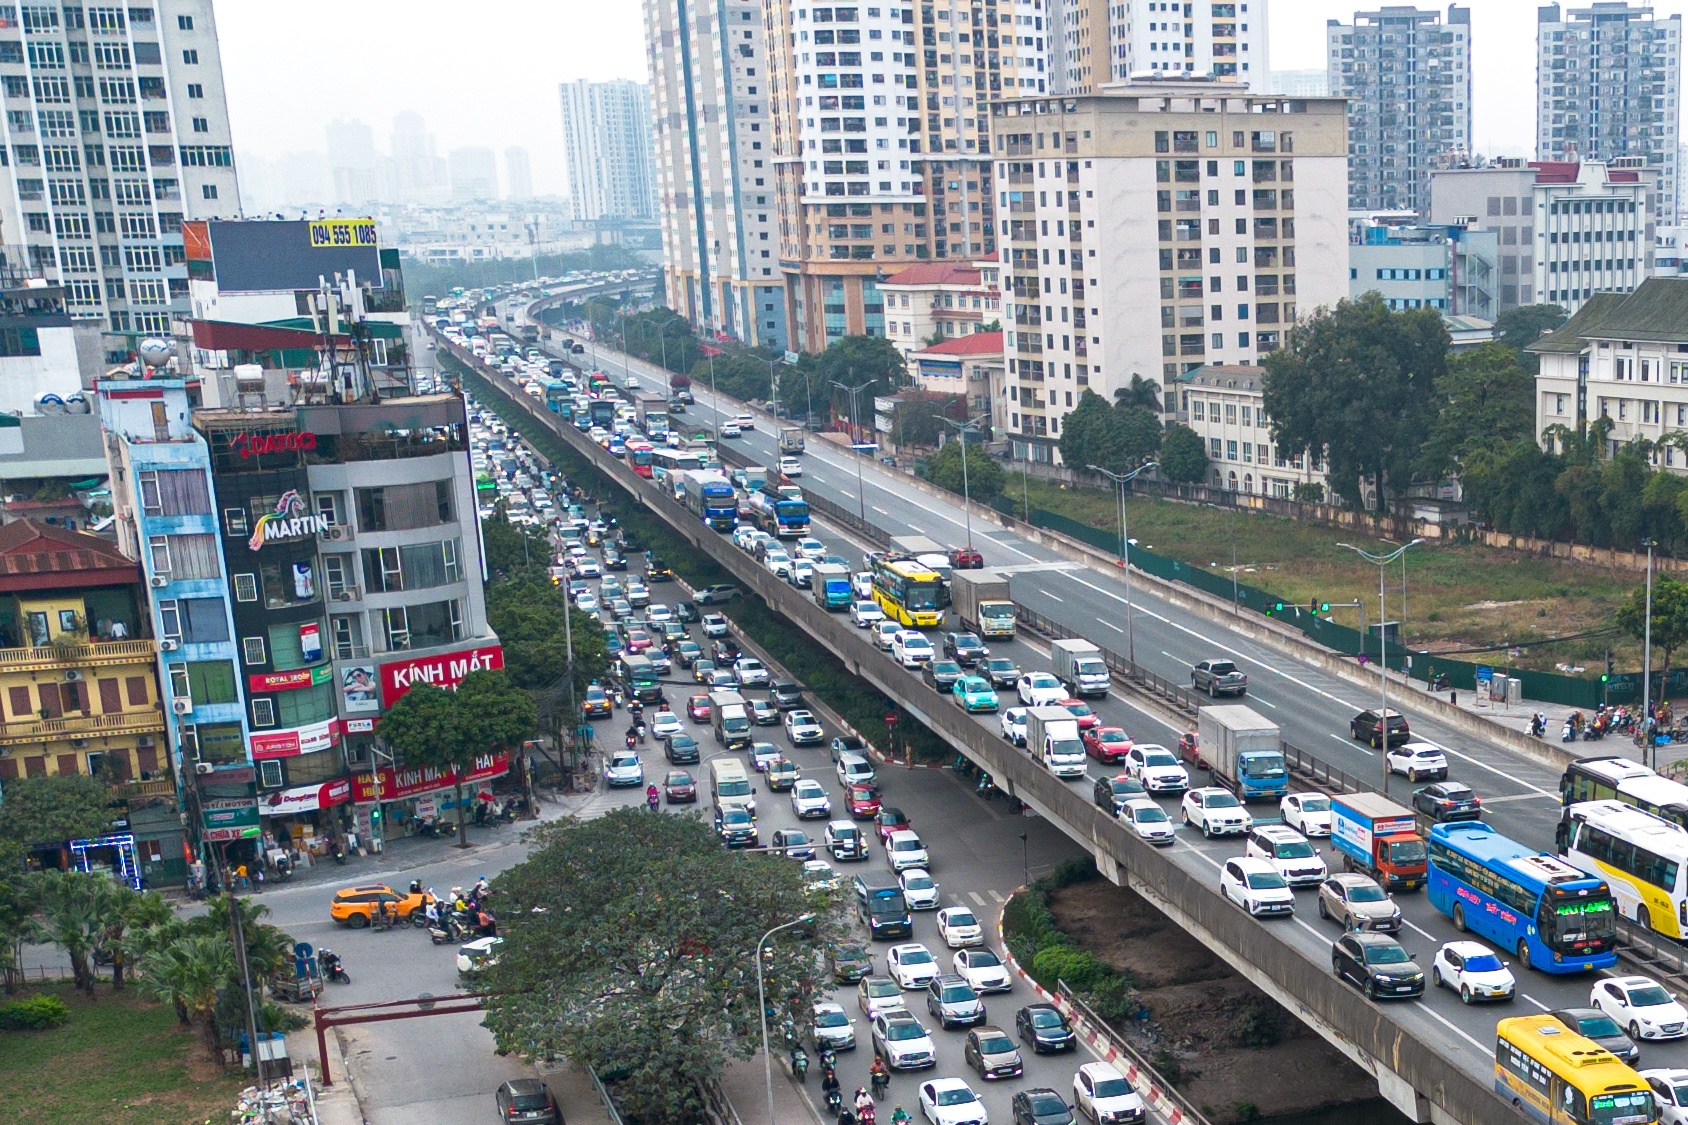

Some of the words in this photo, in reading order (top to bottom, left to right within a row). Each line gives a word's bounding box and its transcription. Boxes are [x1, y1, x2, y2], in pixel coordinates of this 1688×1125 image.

[312, 224, 331, 244] 094
[332, 224, 351, 244] 555
[353, 224, 377, 244] 1085
[265, 513, 329, 540] MARTIN
[393, 662, 444, 689] KÍNH
[450, 650, 494, 680] MẮT
